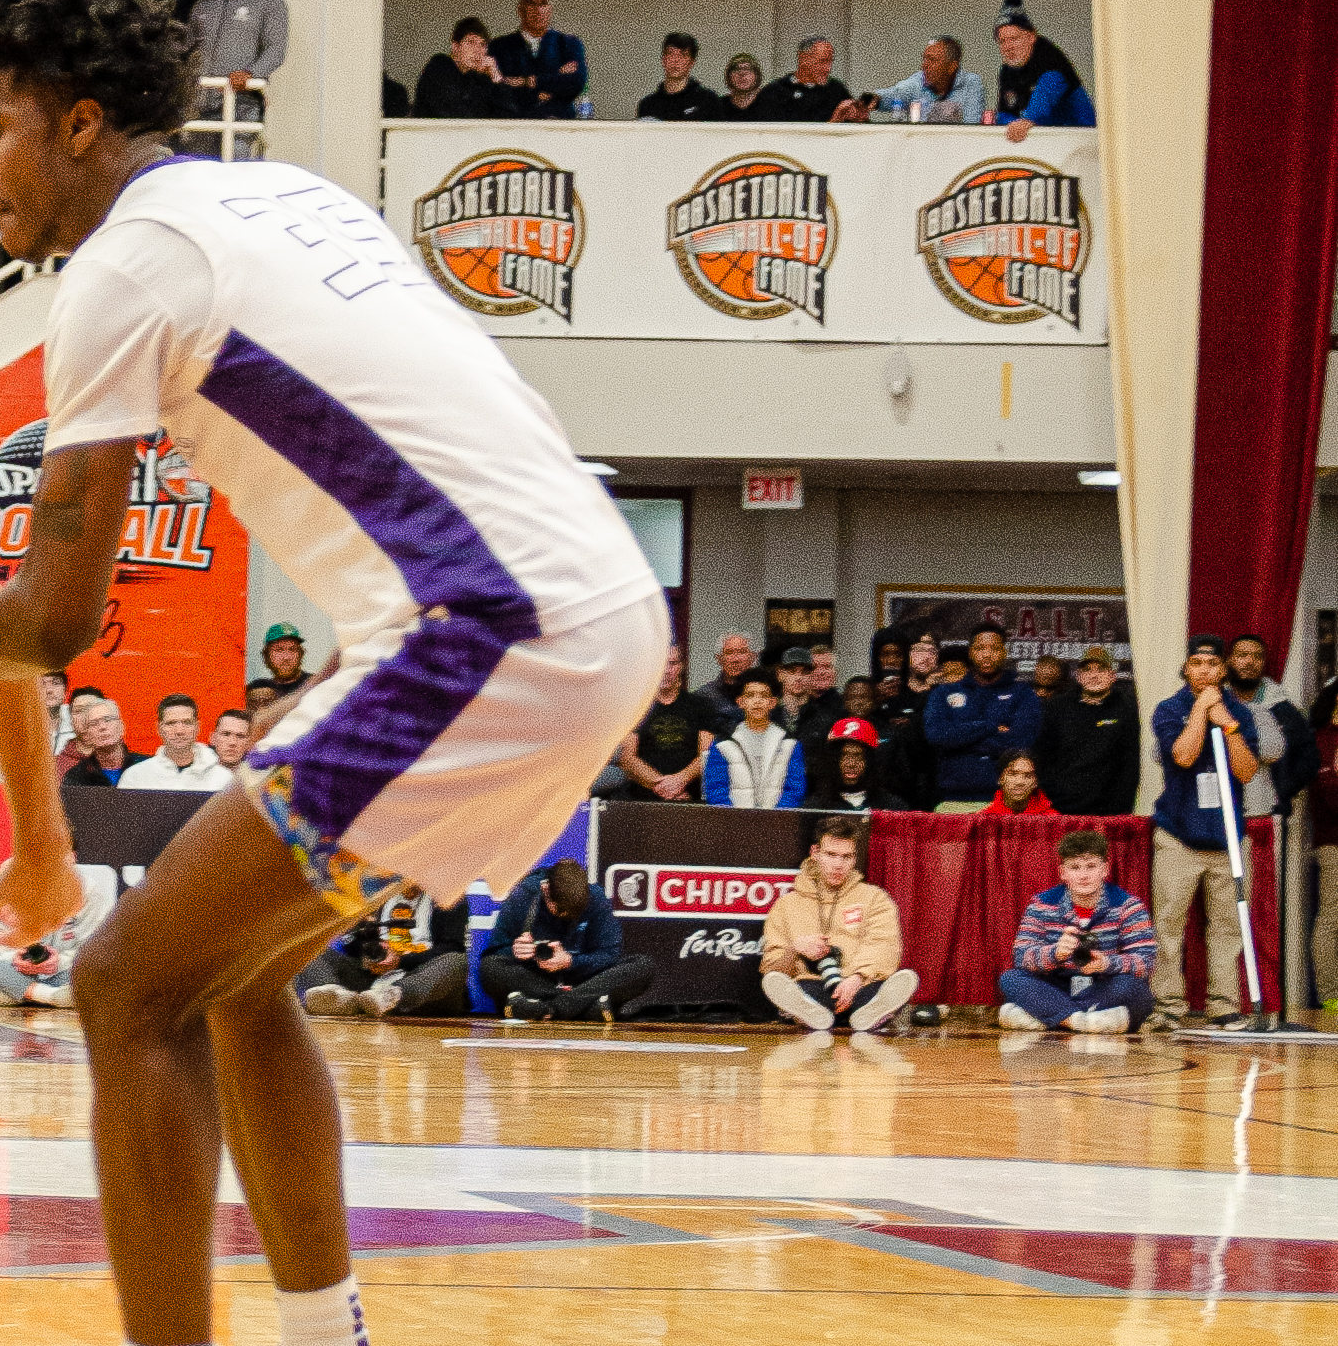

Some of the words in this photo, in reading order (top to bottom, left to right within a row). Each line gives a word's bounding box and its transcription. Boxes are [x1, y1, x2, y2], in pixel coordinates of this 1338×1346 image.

[421, 171, 571, 231] BASKETBALL
[675, 173, 825, 236] BASKETBALL
[926, 177, 1078, 239] BASKETBALL
[504, 253, 570, 317] FAME
[761, 257, 823, 319] FAME
[1011, 261, 1078, 324] FAME
[749, 476, 795, 502] EXIT
